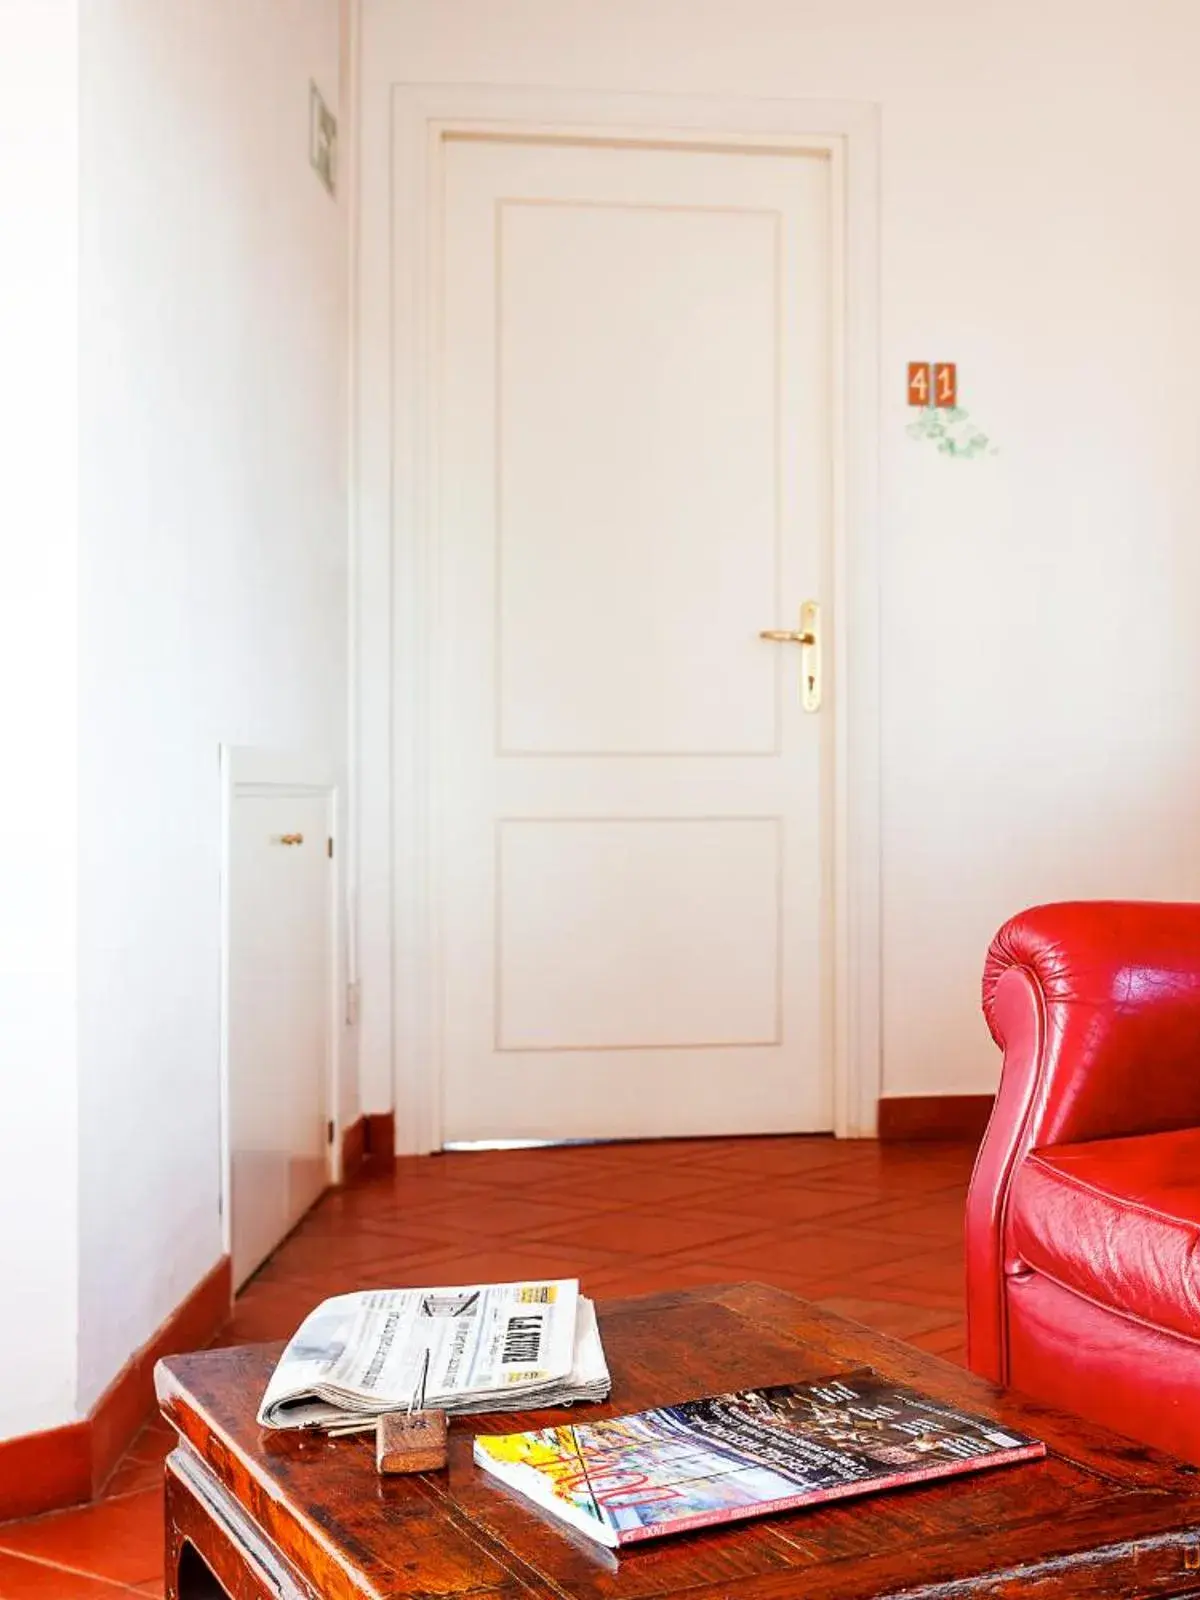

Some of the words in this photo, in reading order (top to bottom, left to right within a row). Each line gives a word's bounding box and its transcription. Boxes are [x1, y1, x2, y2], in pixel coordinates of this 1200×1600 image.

[910, 366, 953, 401] 41
[508, 1315, 543, 1332] LA
[502, 1332, 541, 1364] NUOVA
[519, 1446, 686, 1509] DOVE
